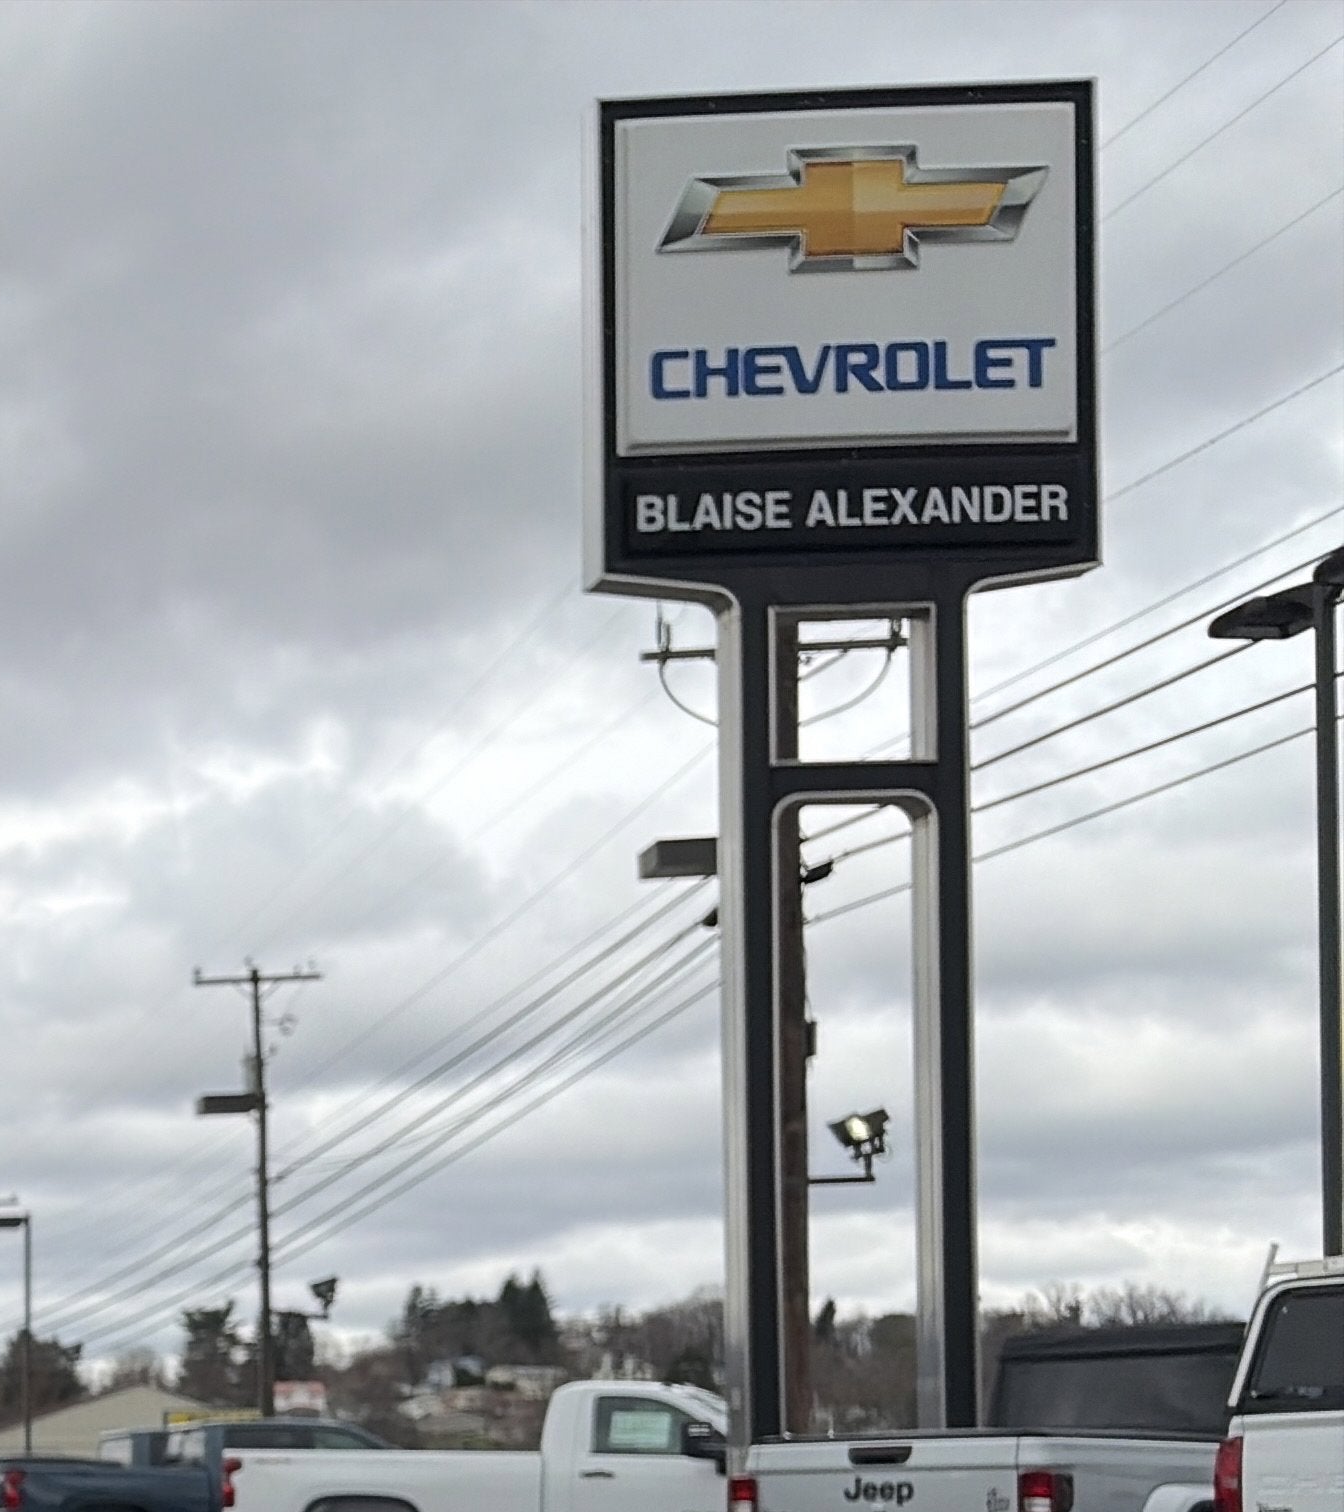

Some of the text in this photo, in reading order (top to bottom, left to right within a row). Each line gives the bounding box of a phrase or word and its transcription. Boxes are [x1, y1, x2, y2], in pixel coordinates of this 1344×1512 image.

[651, 337, 1056, 399] CHEVROLET
[636, 483, 1069, 533] BLAISE ALEXANDER
[843, 1477, 915, 1507] Jeep
